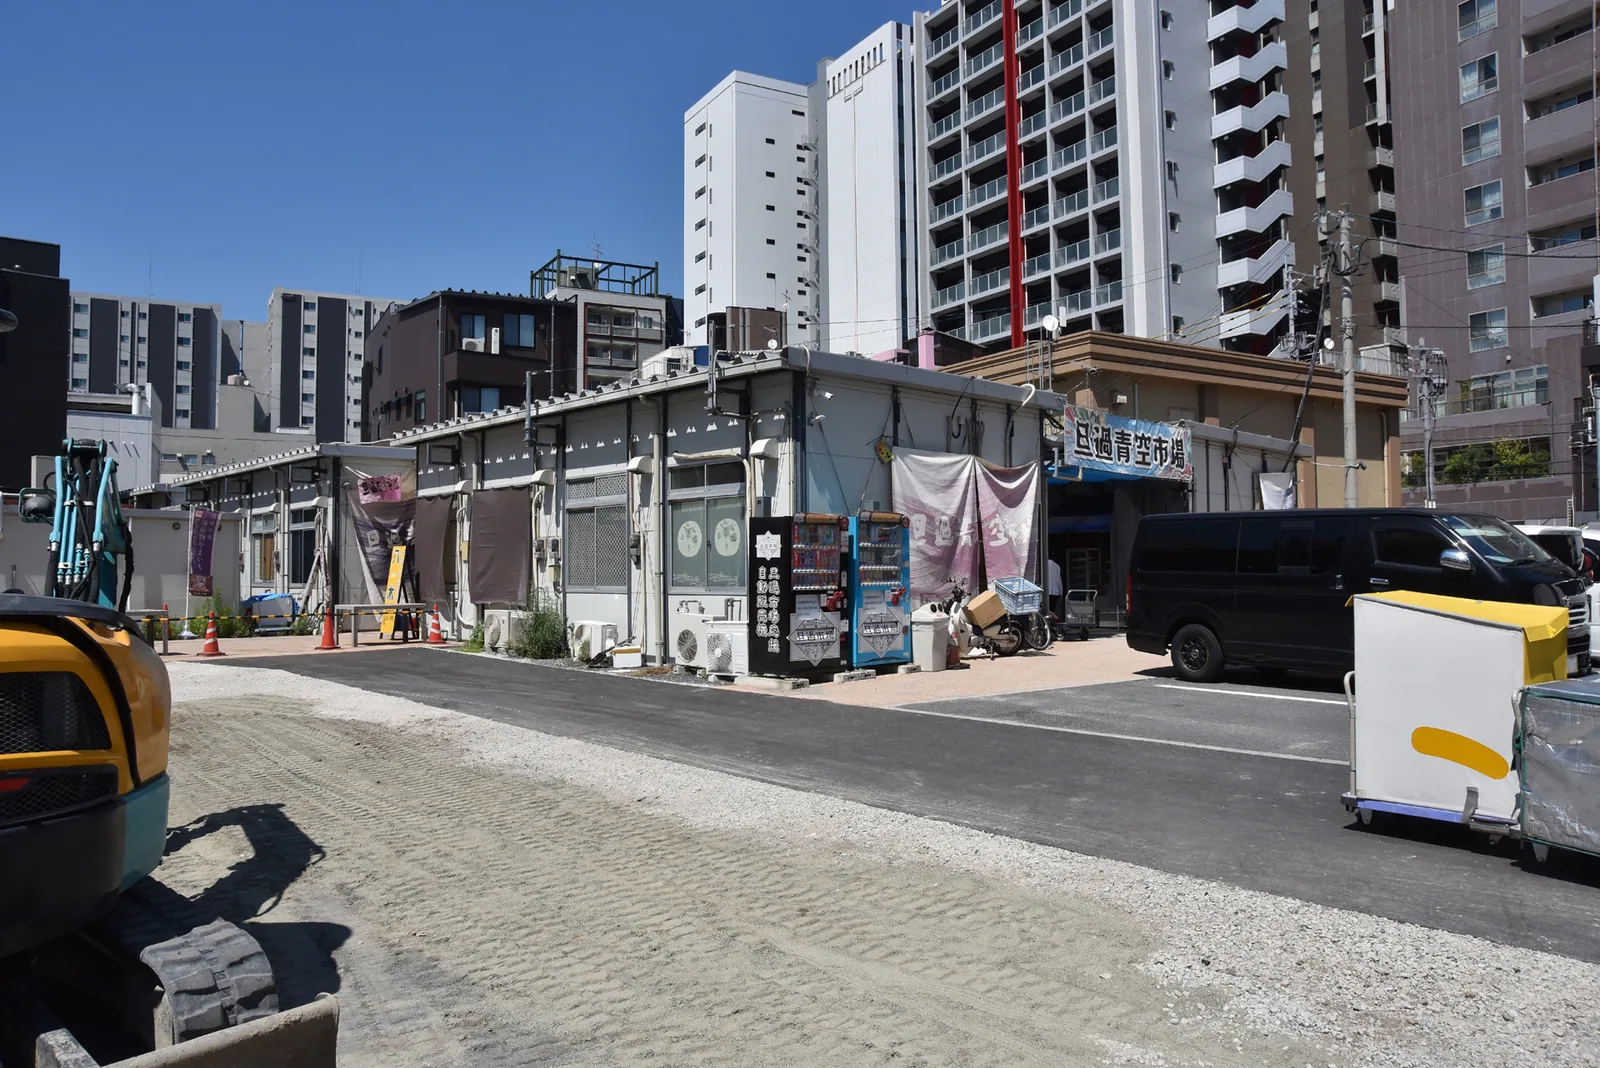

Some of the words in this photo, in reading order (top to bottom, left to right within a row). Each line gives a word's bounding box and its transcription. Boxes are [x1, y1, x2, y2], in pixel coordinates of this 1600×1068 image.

[1074, 420, 1185, 470] 旦過青空市場
